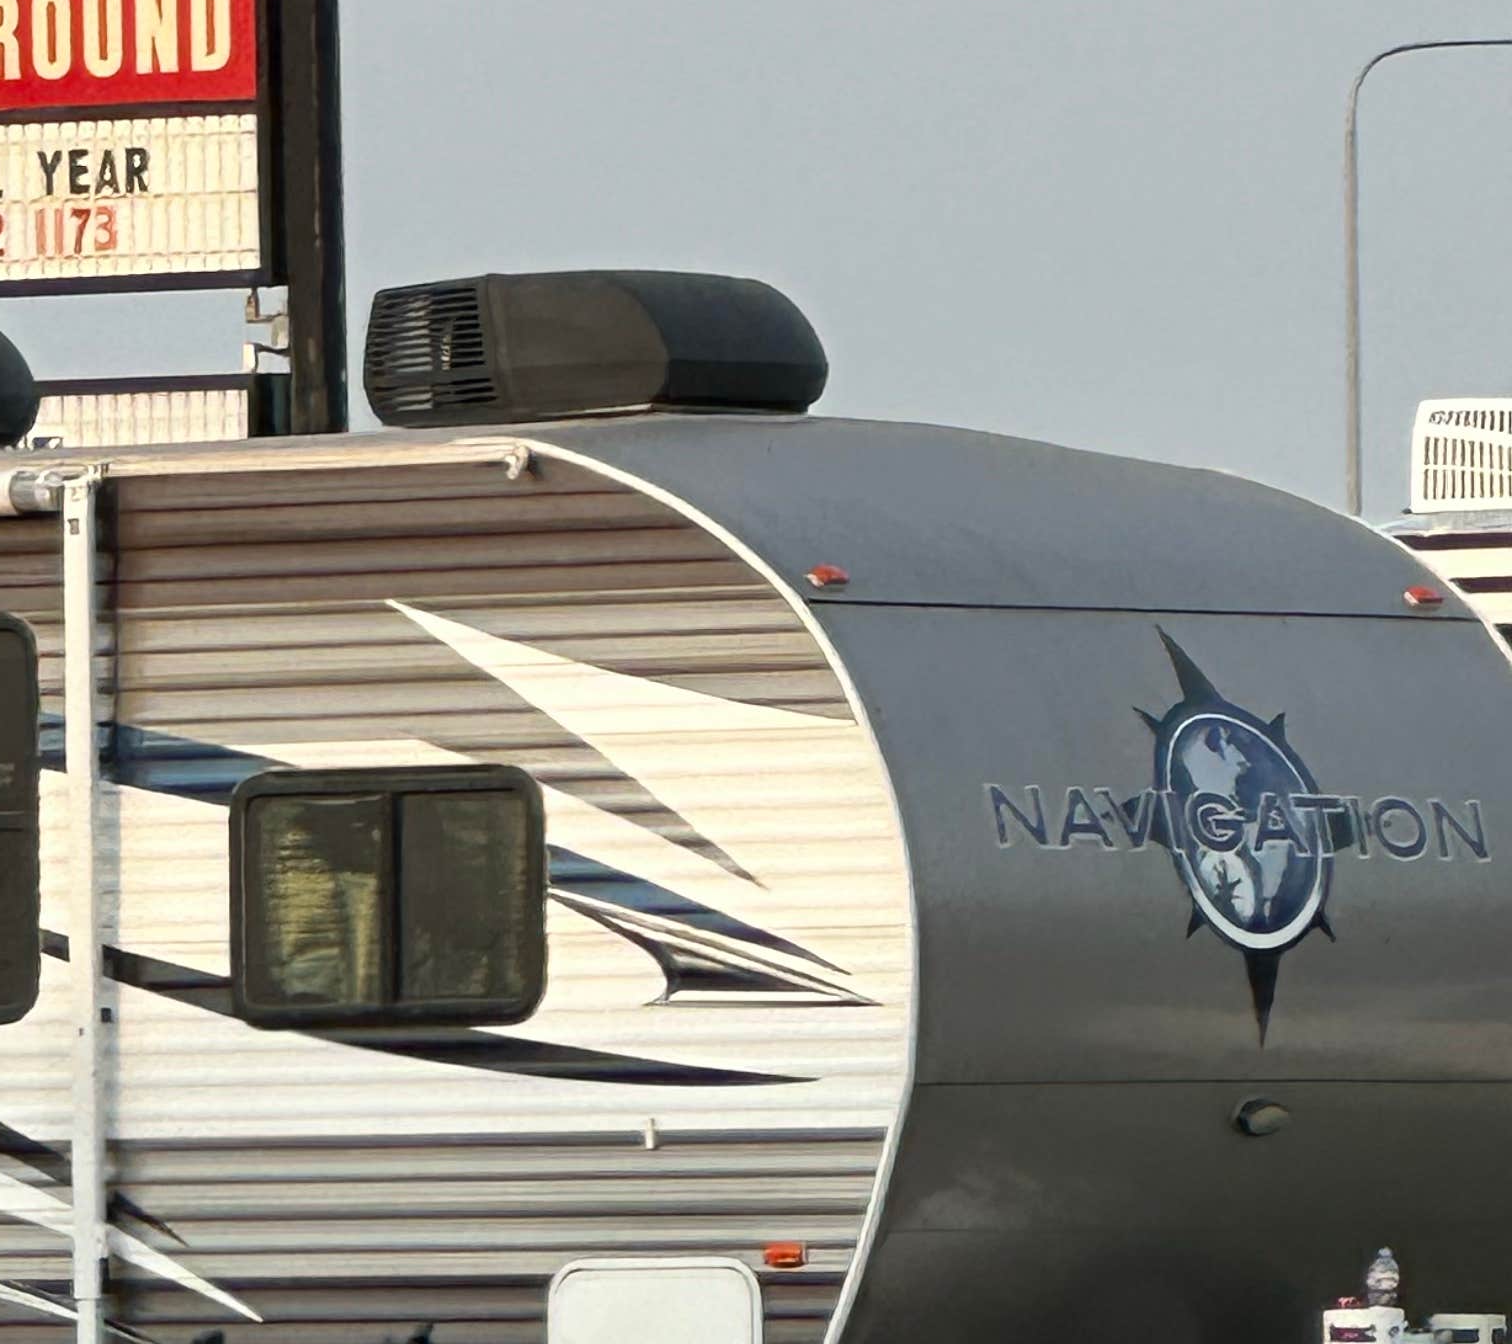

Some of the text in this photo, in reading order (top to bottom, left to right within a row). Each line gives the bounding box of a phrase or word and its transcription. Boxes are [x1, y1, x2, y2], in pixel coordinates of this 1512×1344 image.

[37, 147, 151, 196] YEAR
[38, 207, 118, 256] 1173
[984, 783, 1491, 861] NAVIGATION
